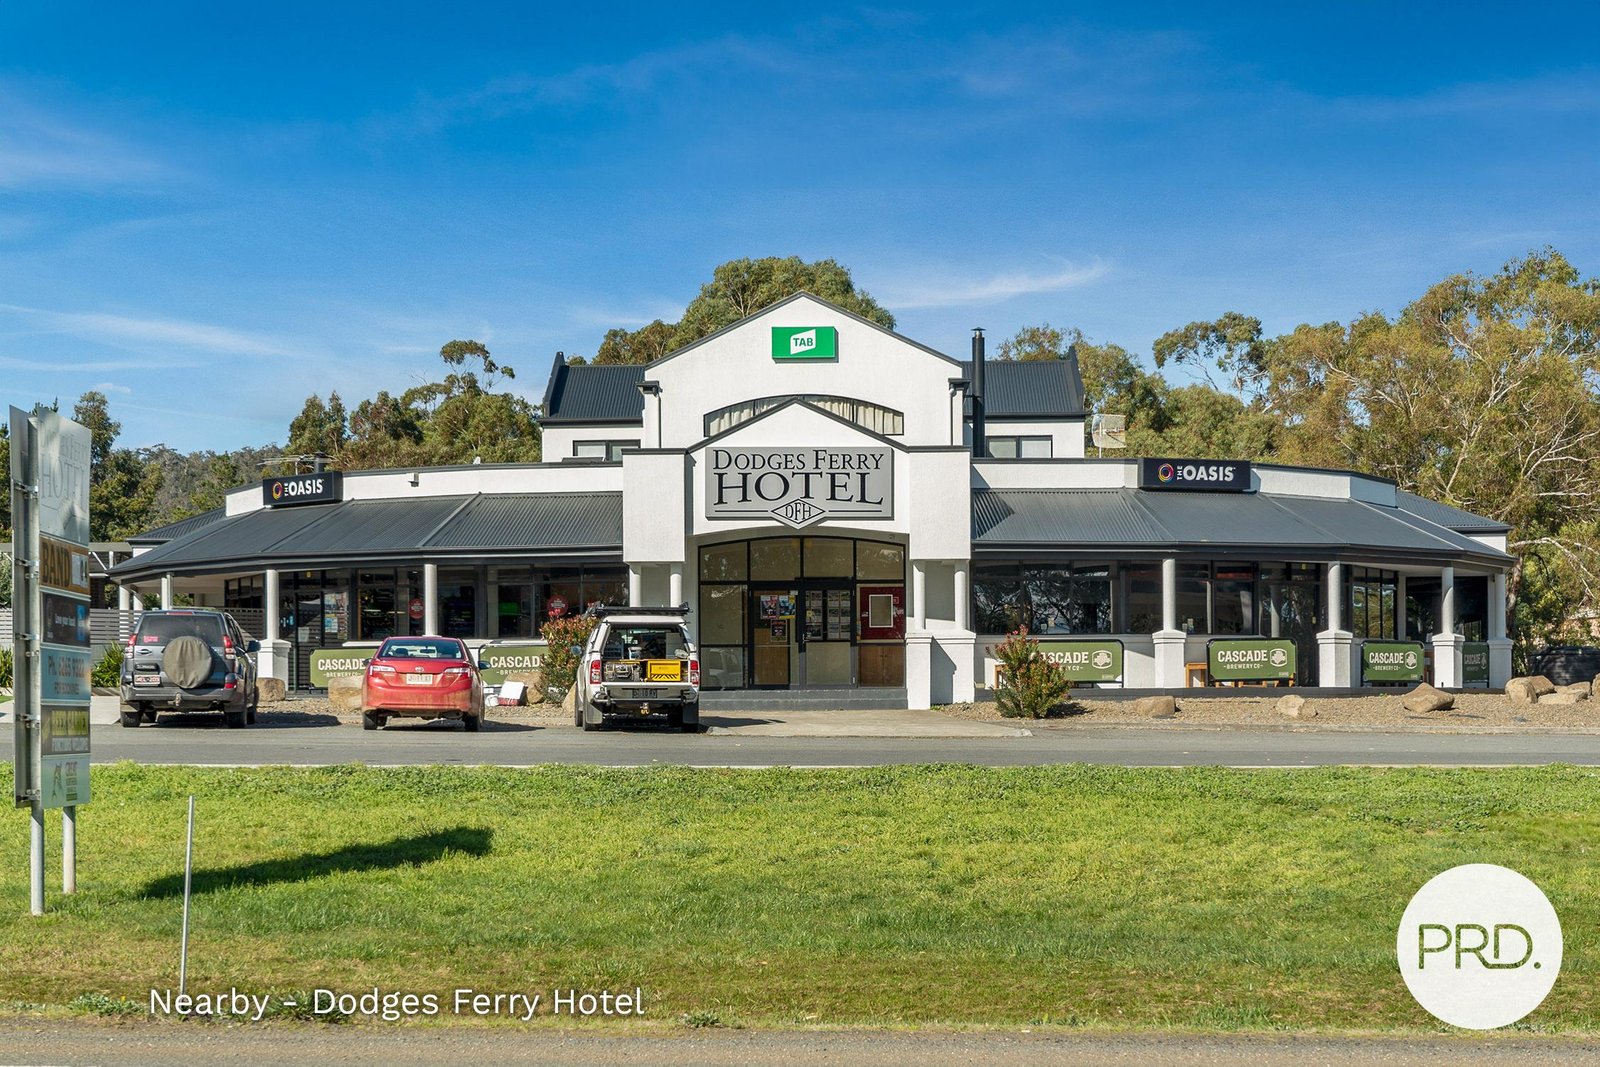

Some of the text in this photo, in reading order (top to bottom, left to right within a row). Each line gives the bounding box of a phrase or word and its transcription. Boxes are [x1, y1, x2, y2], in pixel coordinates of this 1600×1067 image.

[793, 338, 814, 348] TAB
[713, 449, 885, 470] DODGES FERRY
[1183, 465, 1234, 482] OASIS
[289, 478, 323, 497] OASIS
[713, 471, 884, 505] HOTEL
[785, 503, 812, 520] DFH
[42, 541, 71, 588] BAND
[318, 658, 366, 671] CASCADE
[1218, 650, 1268, 662] CASCADE
[1369, 652, 1404, 664] CASCADE
